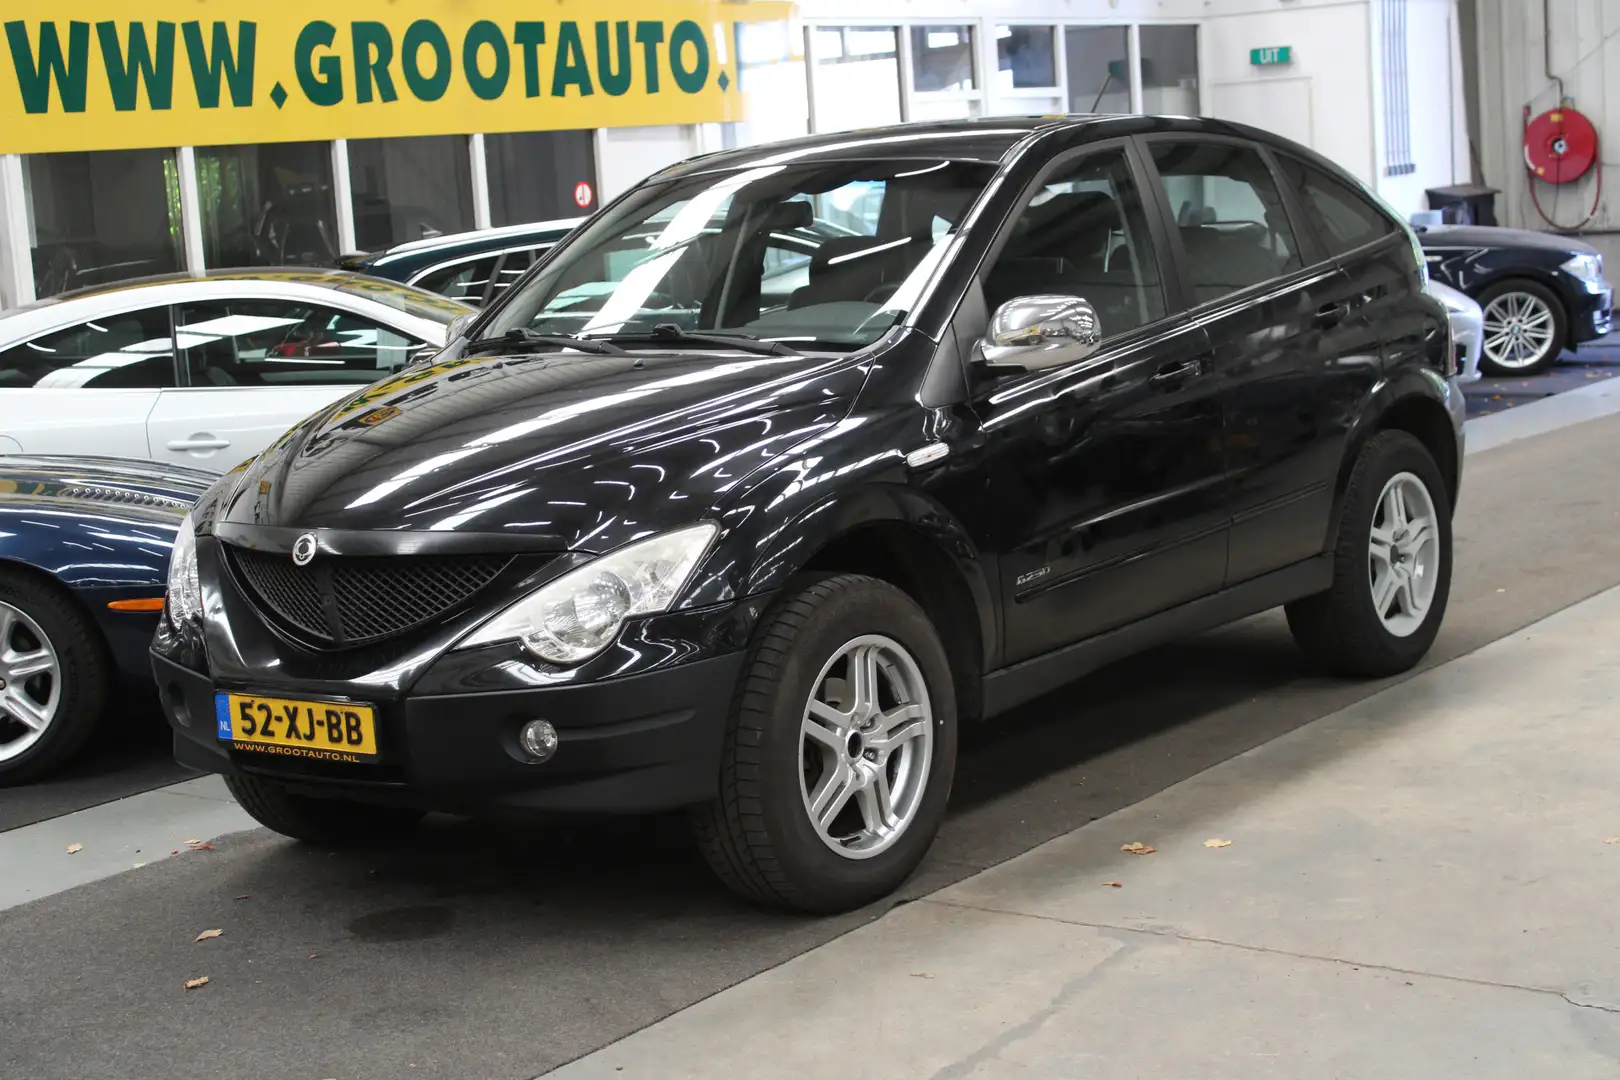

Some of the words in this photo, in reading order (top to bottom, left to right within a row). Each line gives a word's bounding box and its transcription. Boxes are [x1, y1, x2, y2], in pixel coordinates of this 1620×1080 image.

[220, 721, 231, 731] NL
[239, 702, 364, 745] 52-XJ-BB
[234, 743, 360, 763] WWW.GROOTAUTO.NL
